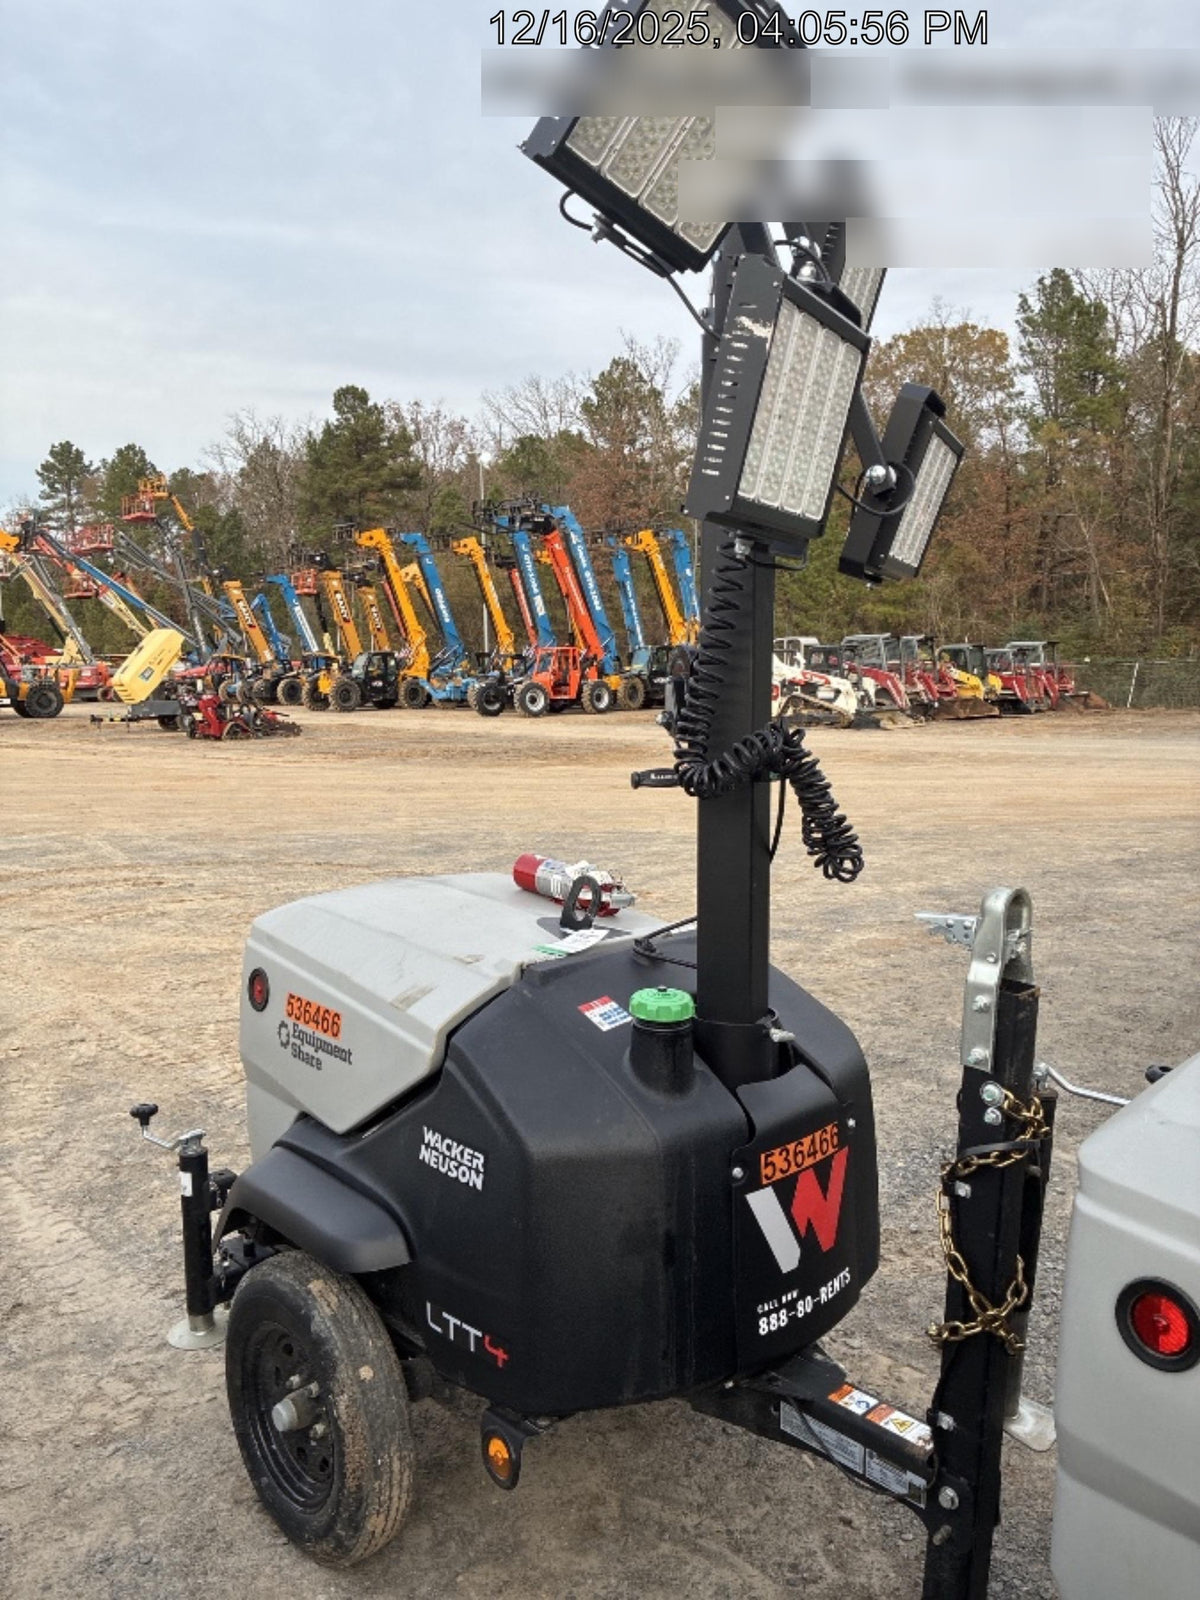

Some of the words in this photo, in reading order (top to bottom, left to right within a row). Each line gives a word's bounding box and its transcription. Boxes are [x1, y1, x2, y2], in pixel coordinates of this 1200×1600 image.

[285, 992, 342, 1038] 536466
[290, 1041, 323, 1071] Share
[291, 1021, 353, 1066] Equipment
[418, 1144, 485, 1192] NEUSON
[422, 1125, 485, 1173] WACKER
[762, 1122, 840, 1182] 536466
[756, 1298, 780, 1314] CALL
[757, 1266, 851, 1336] 888-80-RENTS
[425, 1300, 510, 1368] LTT4
